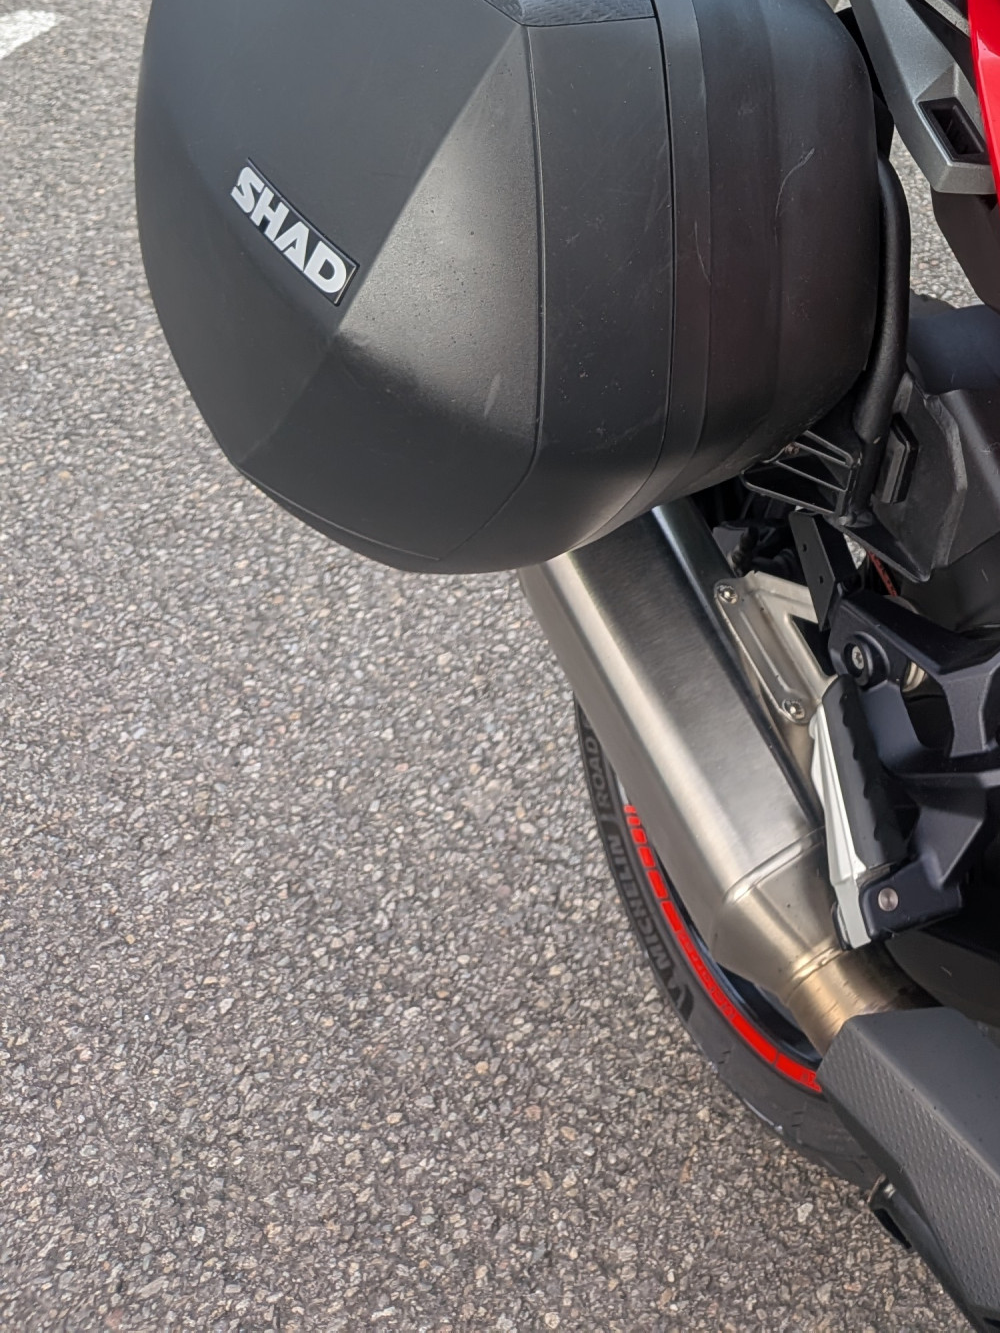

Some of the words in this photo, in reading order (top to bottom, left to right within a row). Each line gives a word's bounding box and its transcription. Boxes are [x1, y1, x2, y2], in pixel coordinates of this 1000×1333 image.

[230, 166, 347, 293] SHAD
[583, 736, 612, 809] ROAD
[607, 834, 672, 971] MICHELIN
